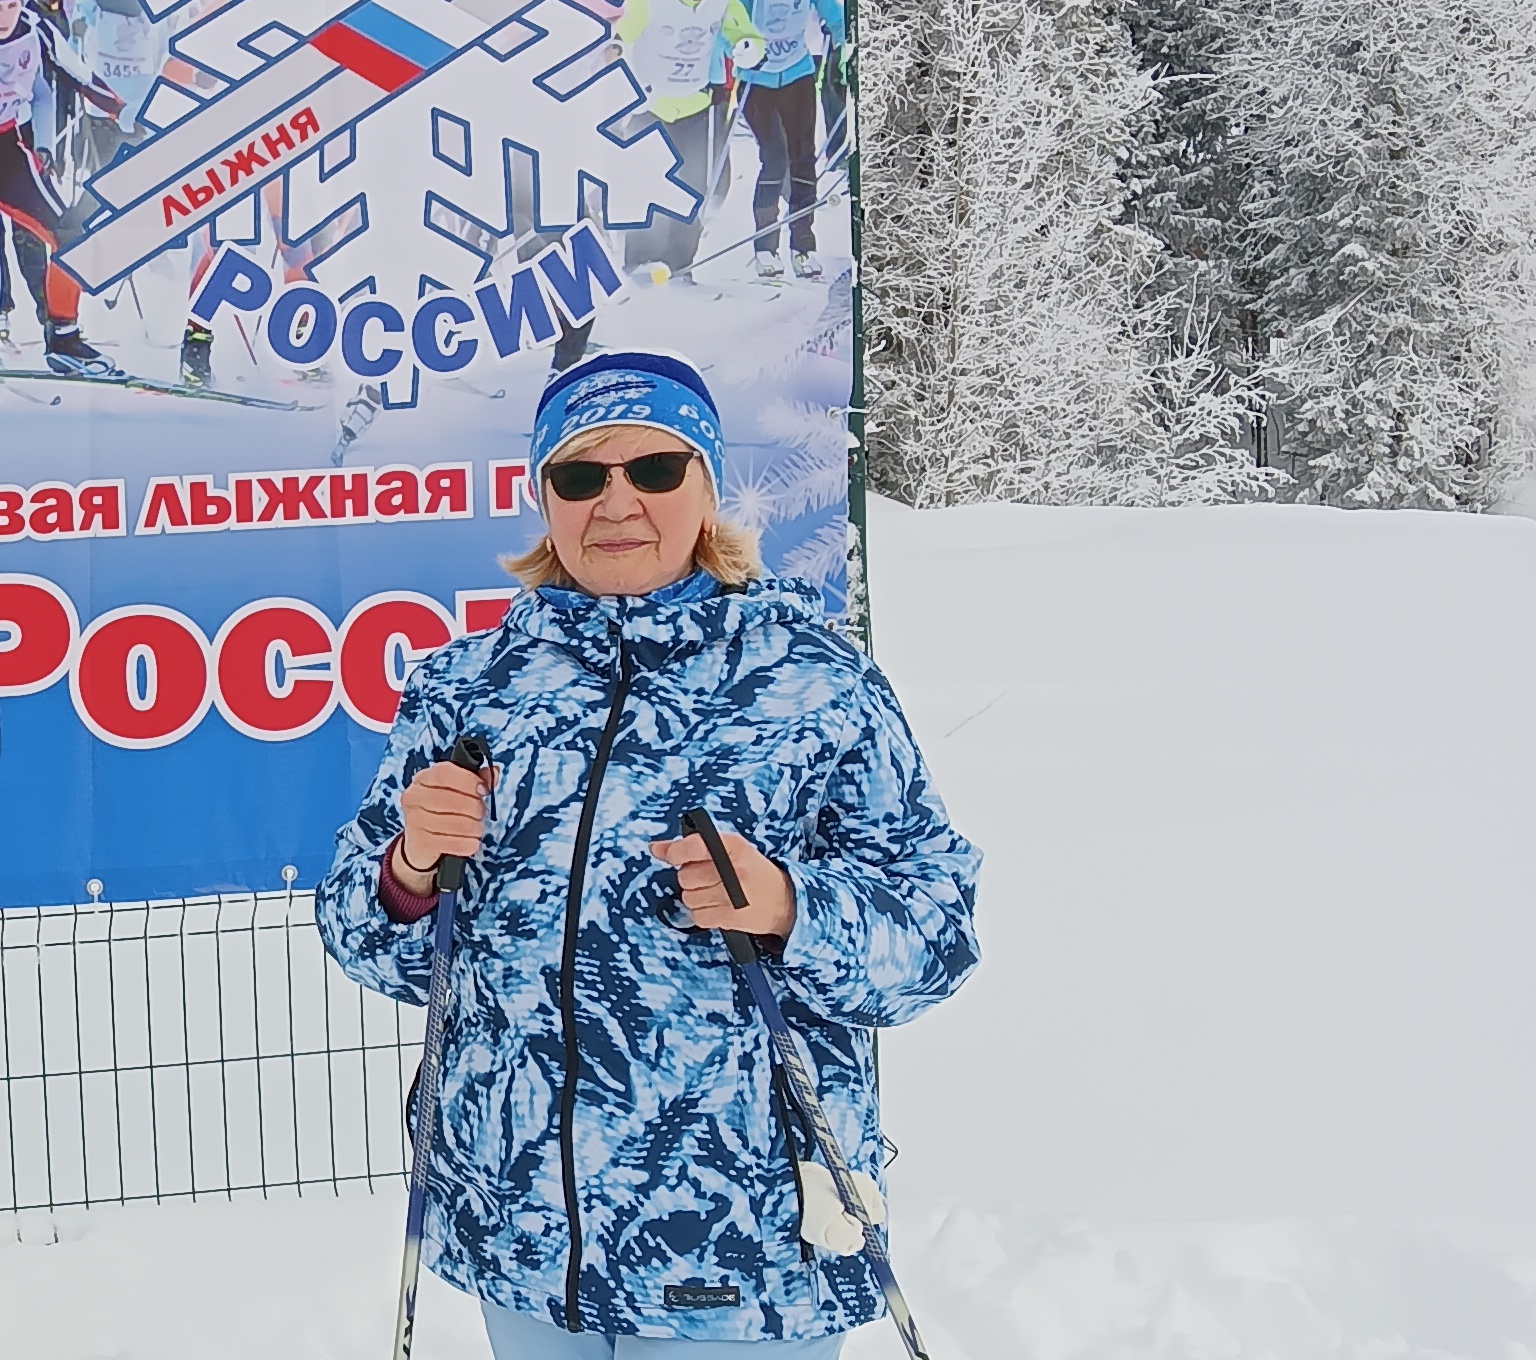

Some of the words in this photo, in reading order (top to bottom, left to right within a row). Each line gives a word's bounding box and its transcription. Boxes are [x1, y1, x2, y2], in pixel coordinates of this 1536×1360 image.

[160, 105, 322, 228] ЛЫЖНЯ
[191, 227, 623, 377] РОССИИ
[559, 403, 652, 438] 2019
[142, 467, 467, 529] лыжная
